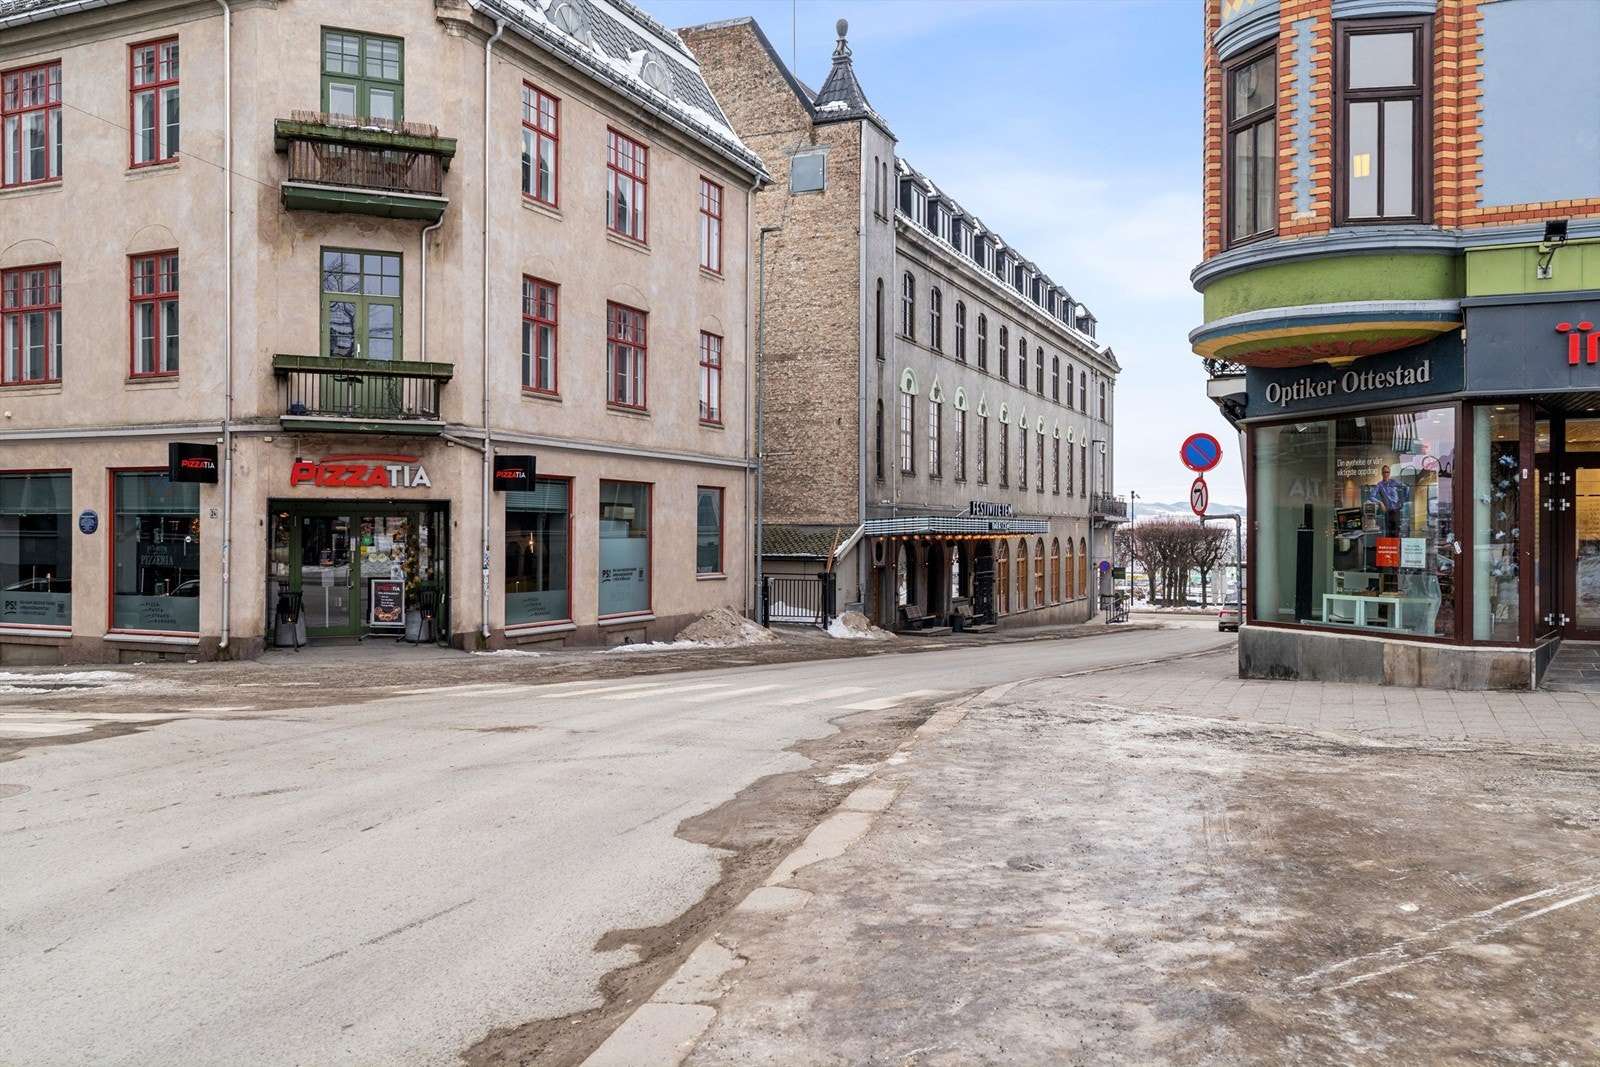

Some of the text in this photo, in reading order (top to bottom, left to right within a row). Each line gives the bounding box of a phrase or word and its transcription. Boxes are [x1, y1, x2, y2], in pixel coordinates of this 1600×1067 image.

[1265, 359, 1431, 407] Optiker Ottestad
[181, 460, 215, 469] PIZZATIA
[290, 462, 432, 487] PIZZATIA
[496, 471, 526, 479] PIZZATIA
[972, 501, 1012, 517] FESTIVITETEN
[141, 555, 173, 565] PIZZERIA
